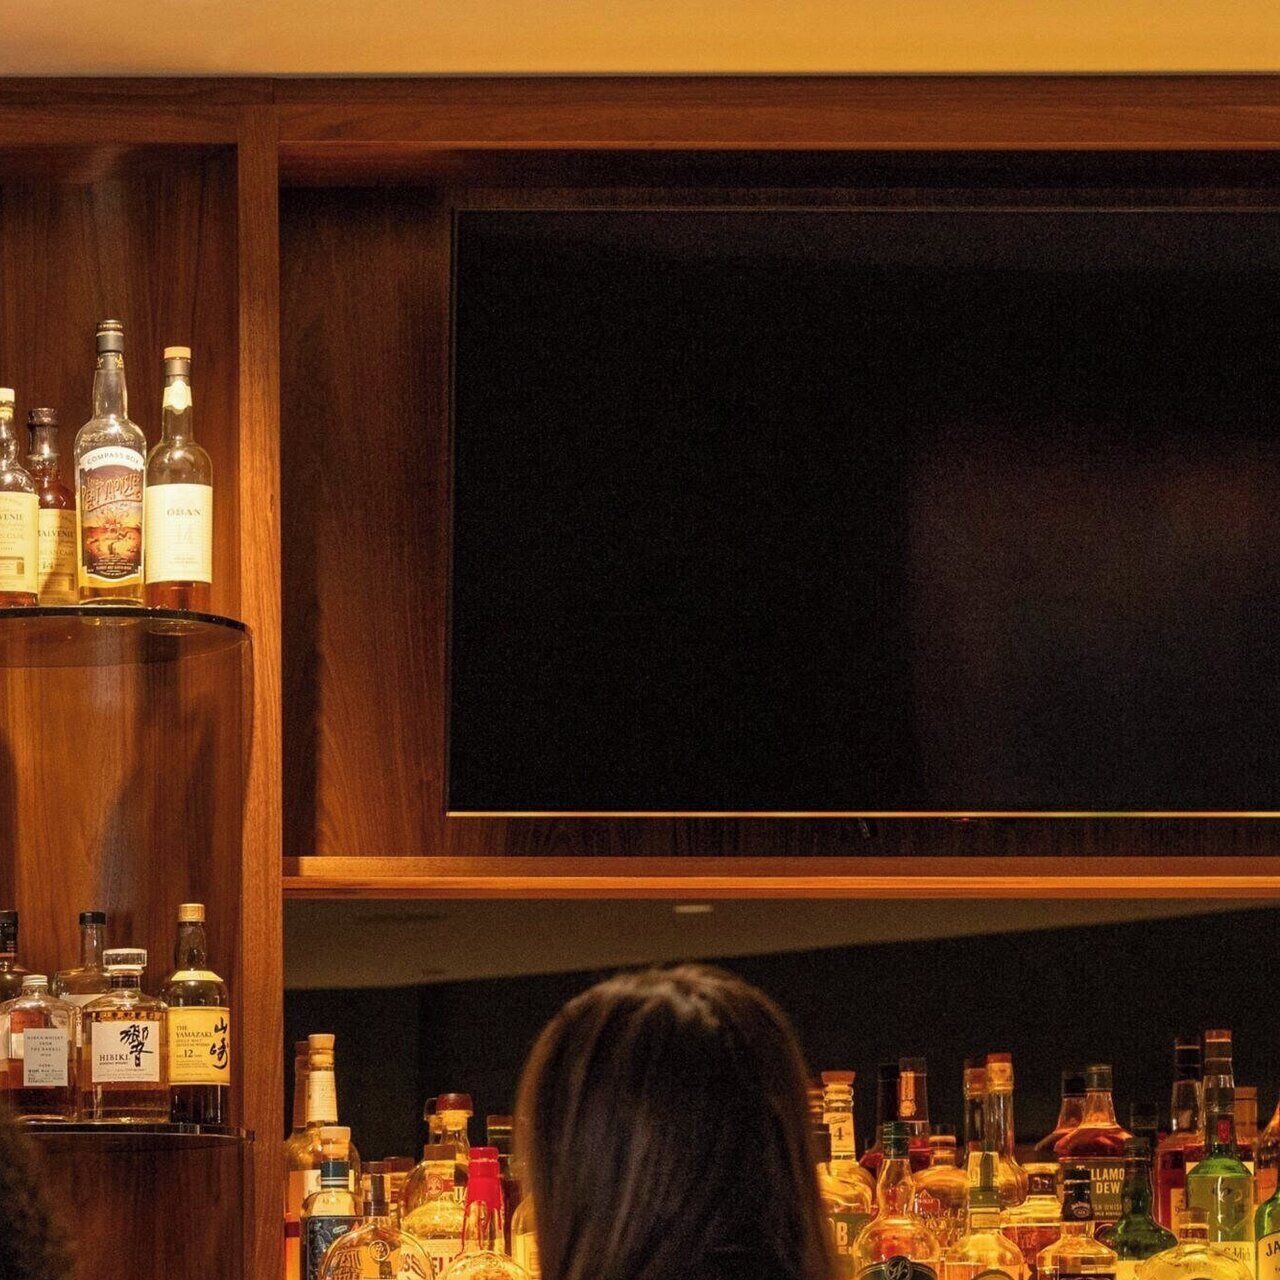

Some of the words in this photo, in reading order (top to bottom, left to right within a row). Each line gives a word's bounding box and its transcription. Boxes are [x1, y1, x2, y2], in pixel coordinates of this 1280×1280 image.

[167, 508, 201, 516] OBAN
[184, 1049, 194, 1057] 12
[99, 1054, 128, 1062] HIBIKI
[1096, 1182, 1121, 1194] DEW
